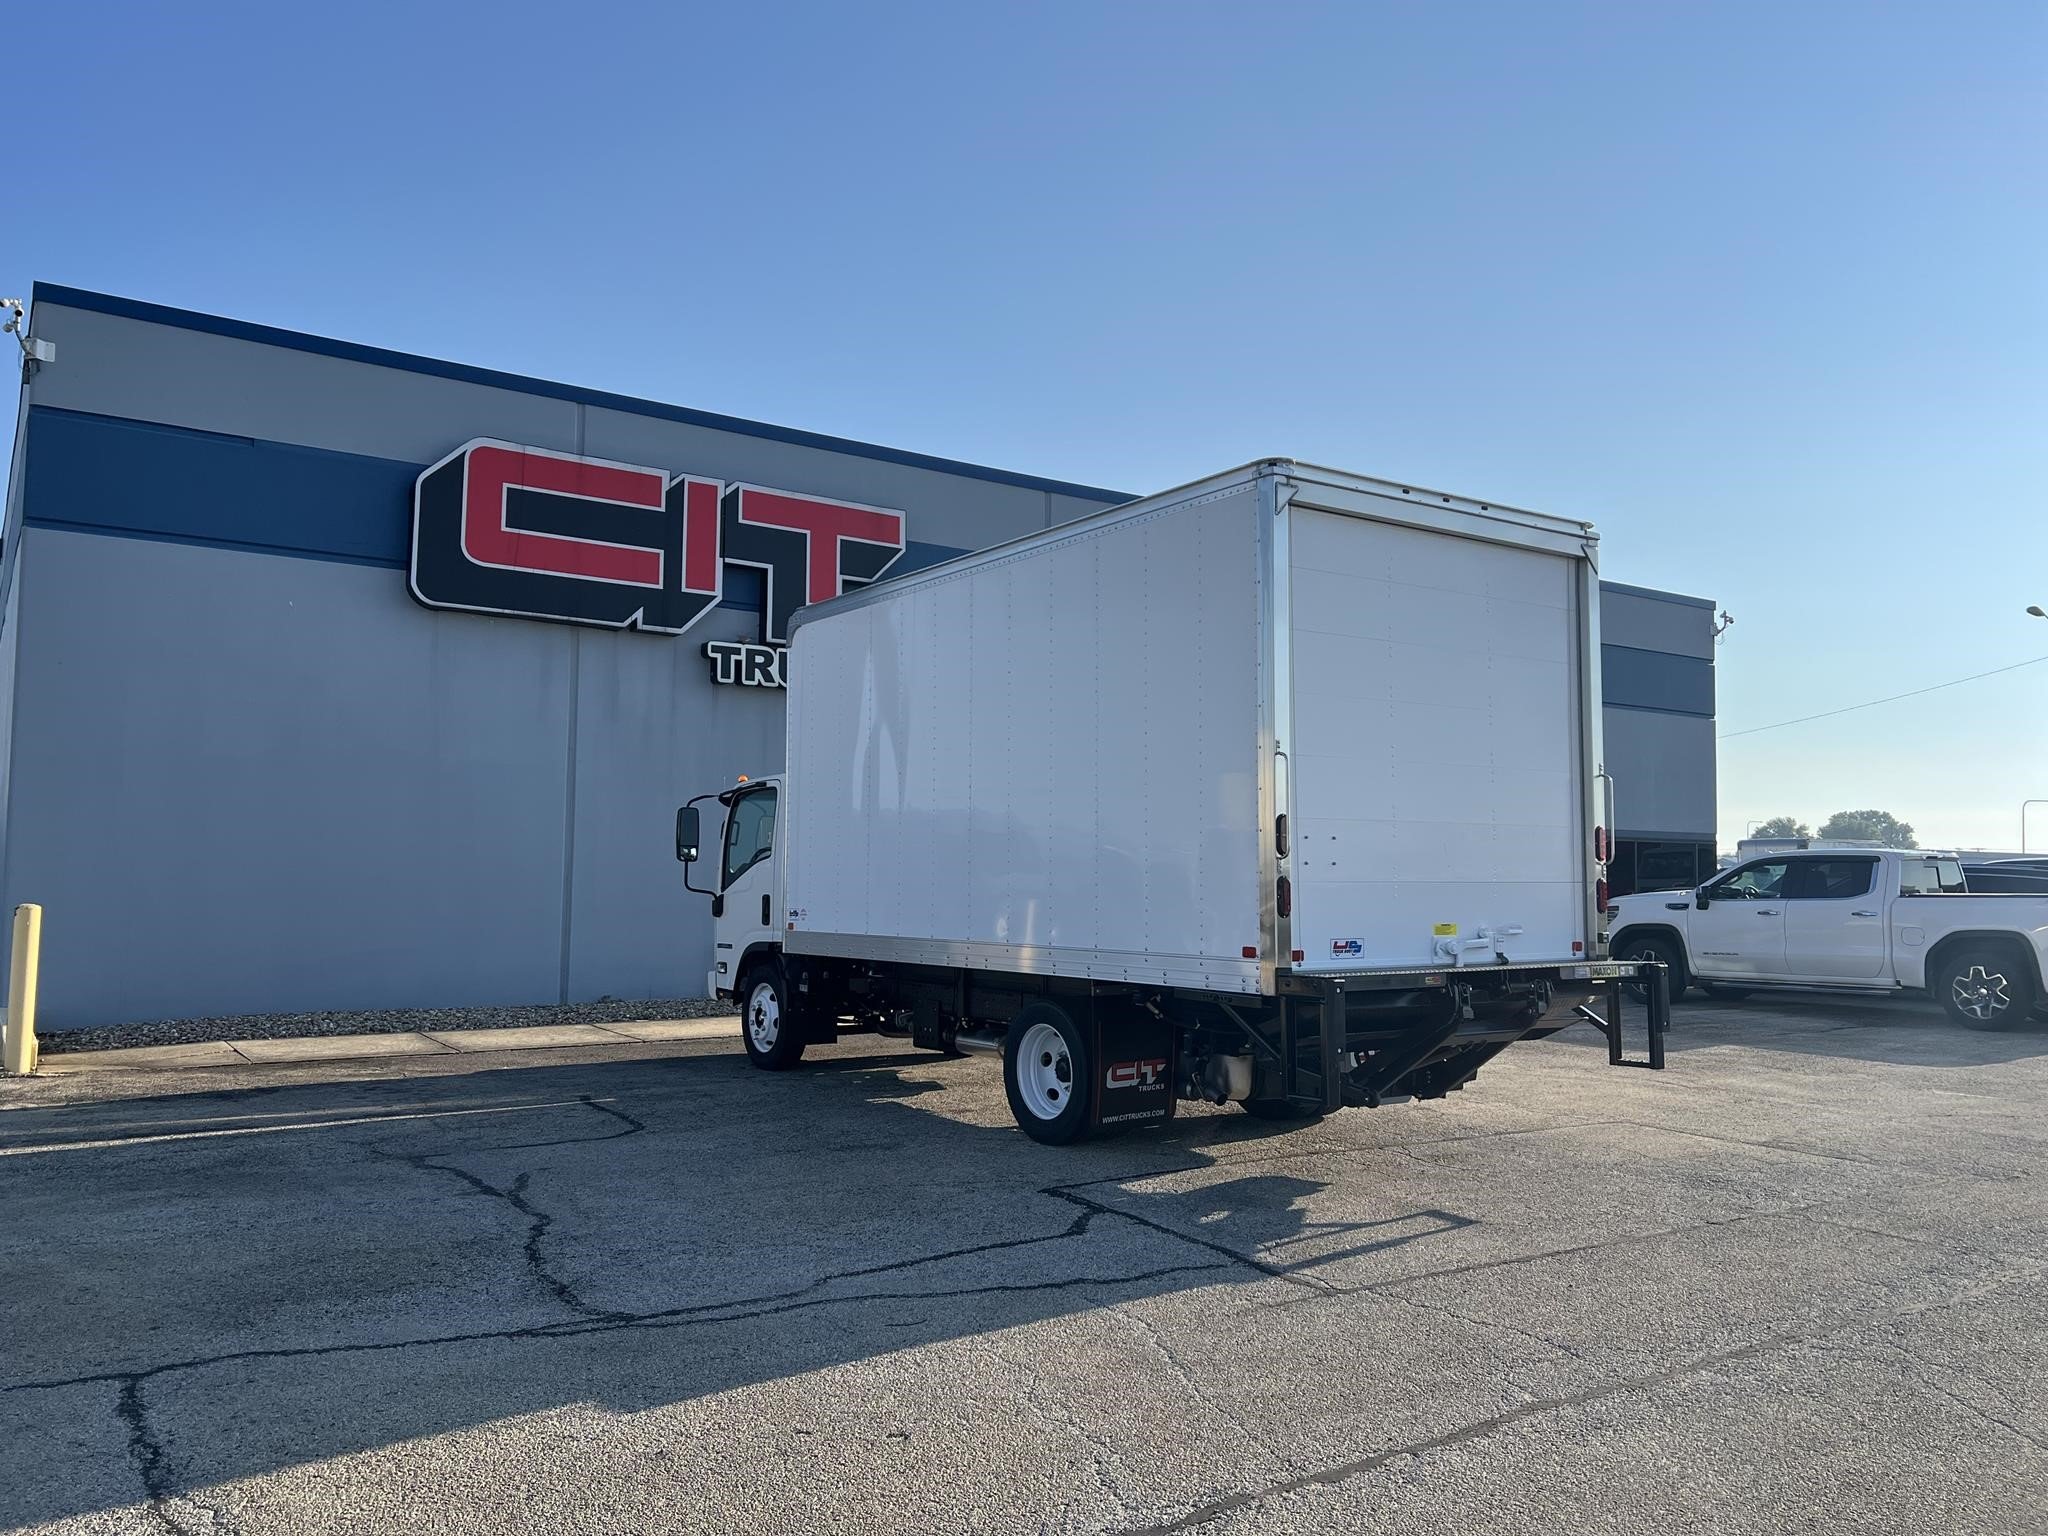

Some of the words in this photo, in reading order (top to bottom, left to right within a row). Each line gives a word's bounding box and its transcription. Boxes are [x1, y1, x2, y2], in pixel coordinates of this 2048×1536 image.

[410, 437, 906, 642] CIT
[1592, 966, 1618, 977] MAXON
[1106, 1058, 1168, 1089] CIT
[1138, 1083, 1165, 1092] TRUCKS
[1102, 1109, 1165, 1124] WWW.CITTRUCKS.COM
